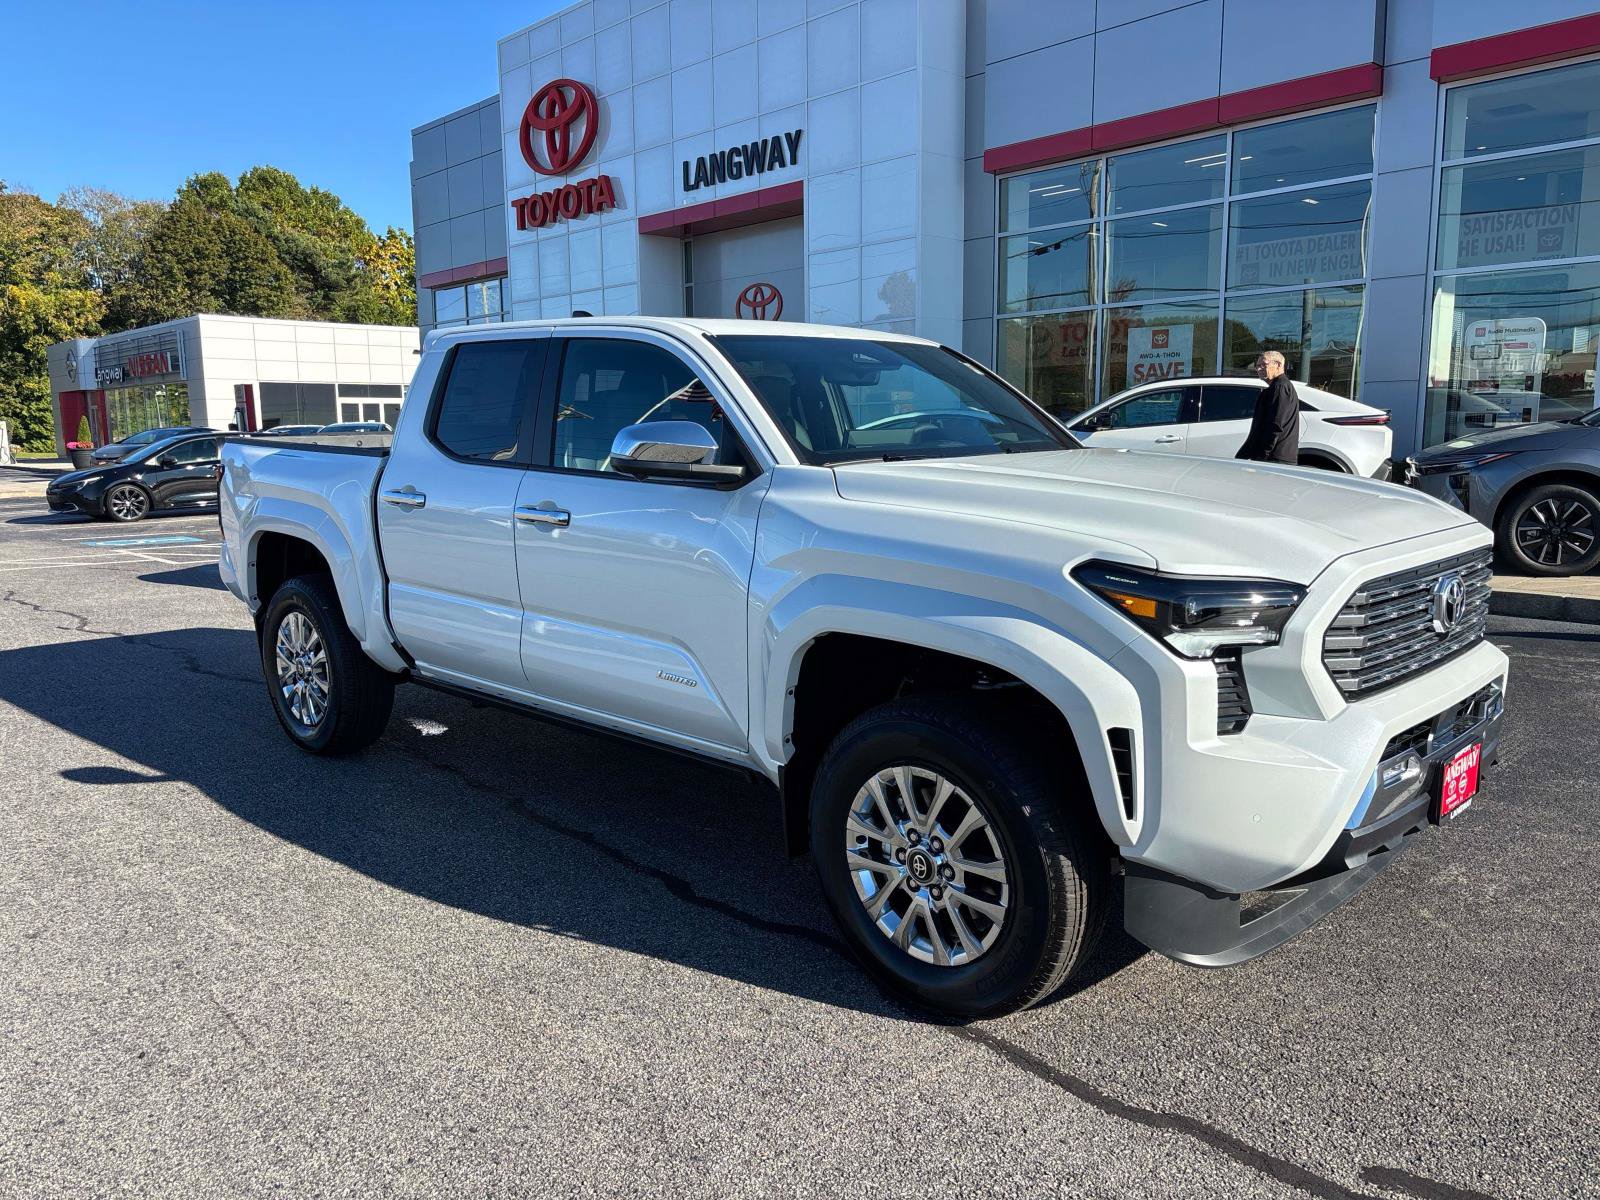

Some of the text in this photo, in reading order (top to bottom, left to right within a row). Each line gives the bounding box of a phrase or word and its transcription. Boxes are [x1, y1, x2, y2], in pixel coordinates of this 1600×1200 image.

[683, 129, 802, 192] LANGWAY
[511, 174, 616, 231] TOYOTA
[1463, 206, 1575, 236] SATISFACTION
[1255, 240, 1304, 260] TOYOTA
[1308, 233, 1356, 253] DEALER
[1459, 232, 1526, 258] HE USA!!
[1269, 261, 1283, 279] IN
[1286, 258, 1317, 277] NEW
[95, 351, 171, 384] angway NISSAN
[1139, 351, 1181, 360] AWD-A-THON
[1133, 361, 1185, 379] SAVE
[1105, 576, 1138, 584] TACOMA
